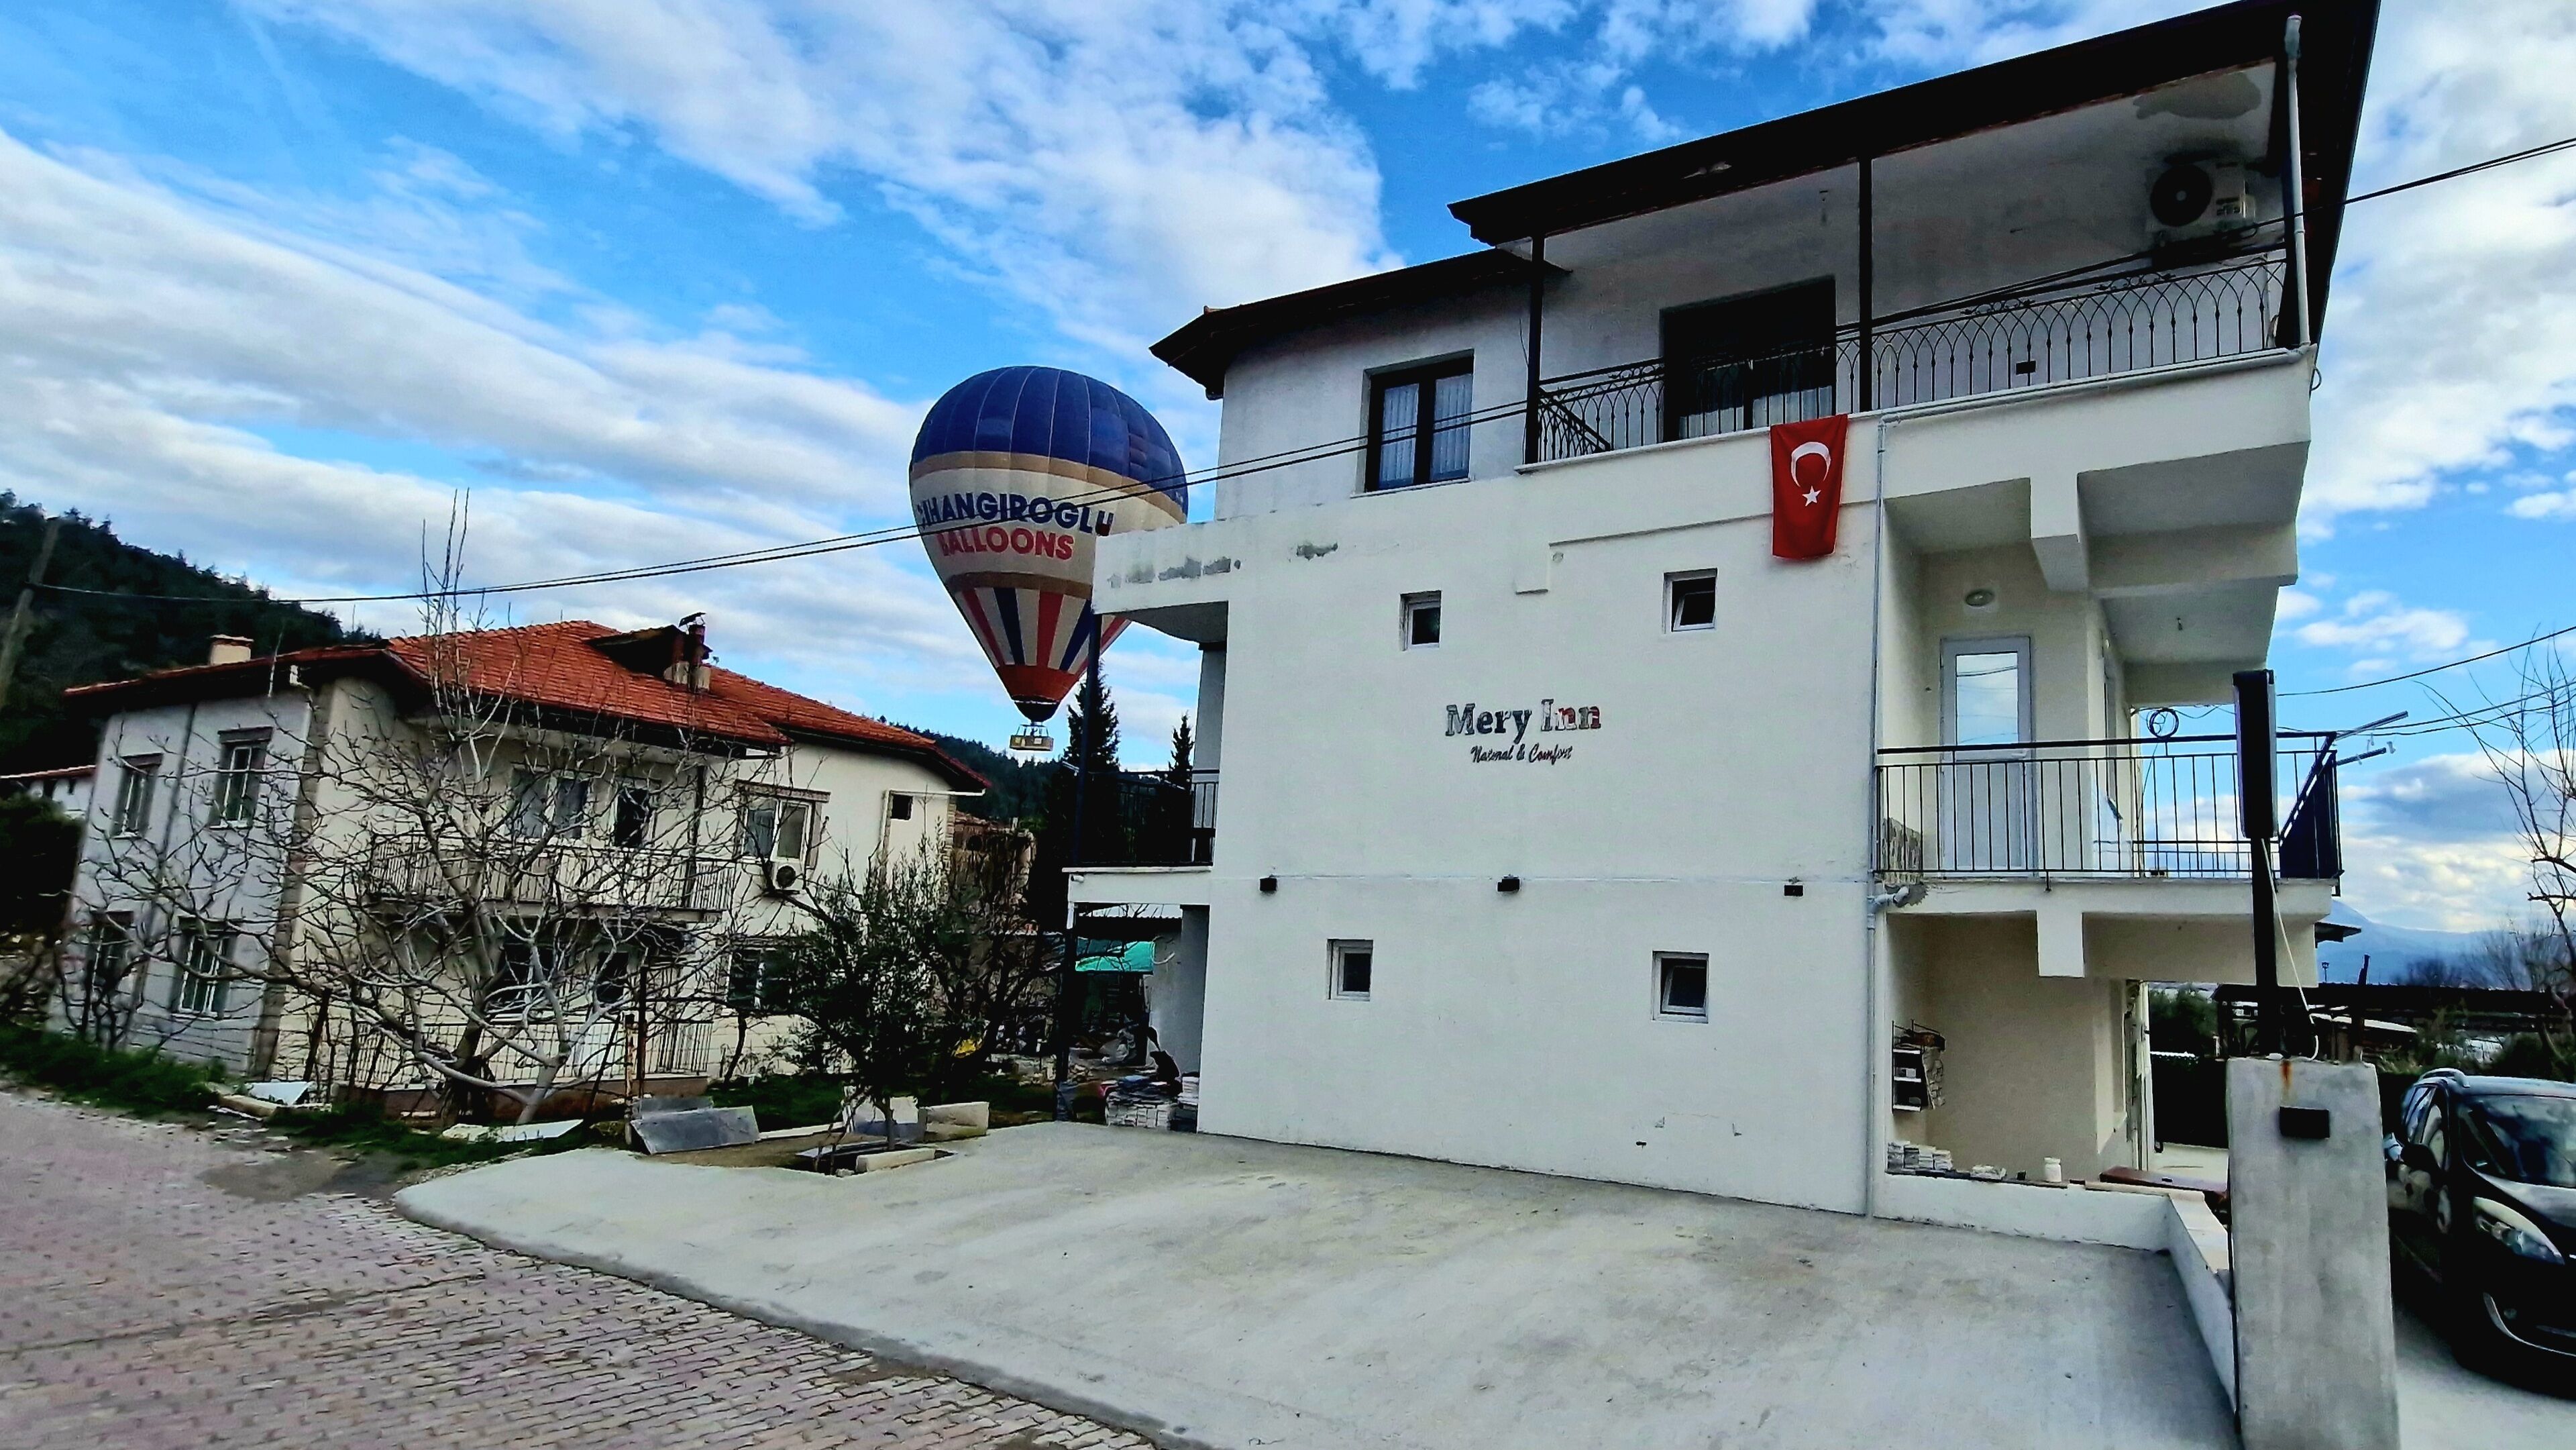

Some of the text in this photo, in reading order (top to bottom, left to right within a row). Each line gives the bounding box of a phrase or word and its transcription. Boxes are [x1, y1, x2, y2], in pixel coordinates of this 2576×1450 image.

[937, 527, 1074, 560] BALLOONS
[1445, 698, 1601, 745] Mery Inn
[1470, 742, 1573, 766] Natural & Comfort
